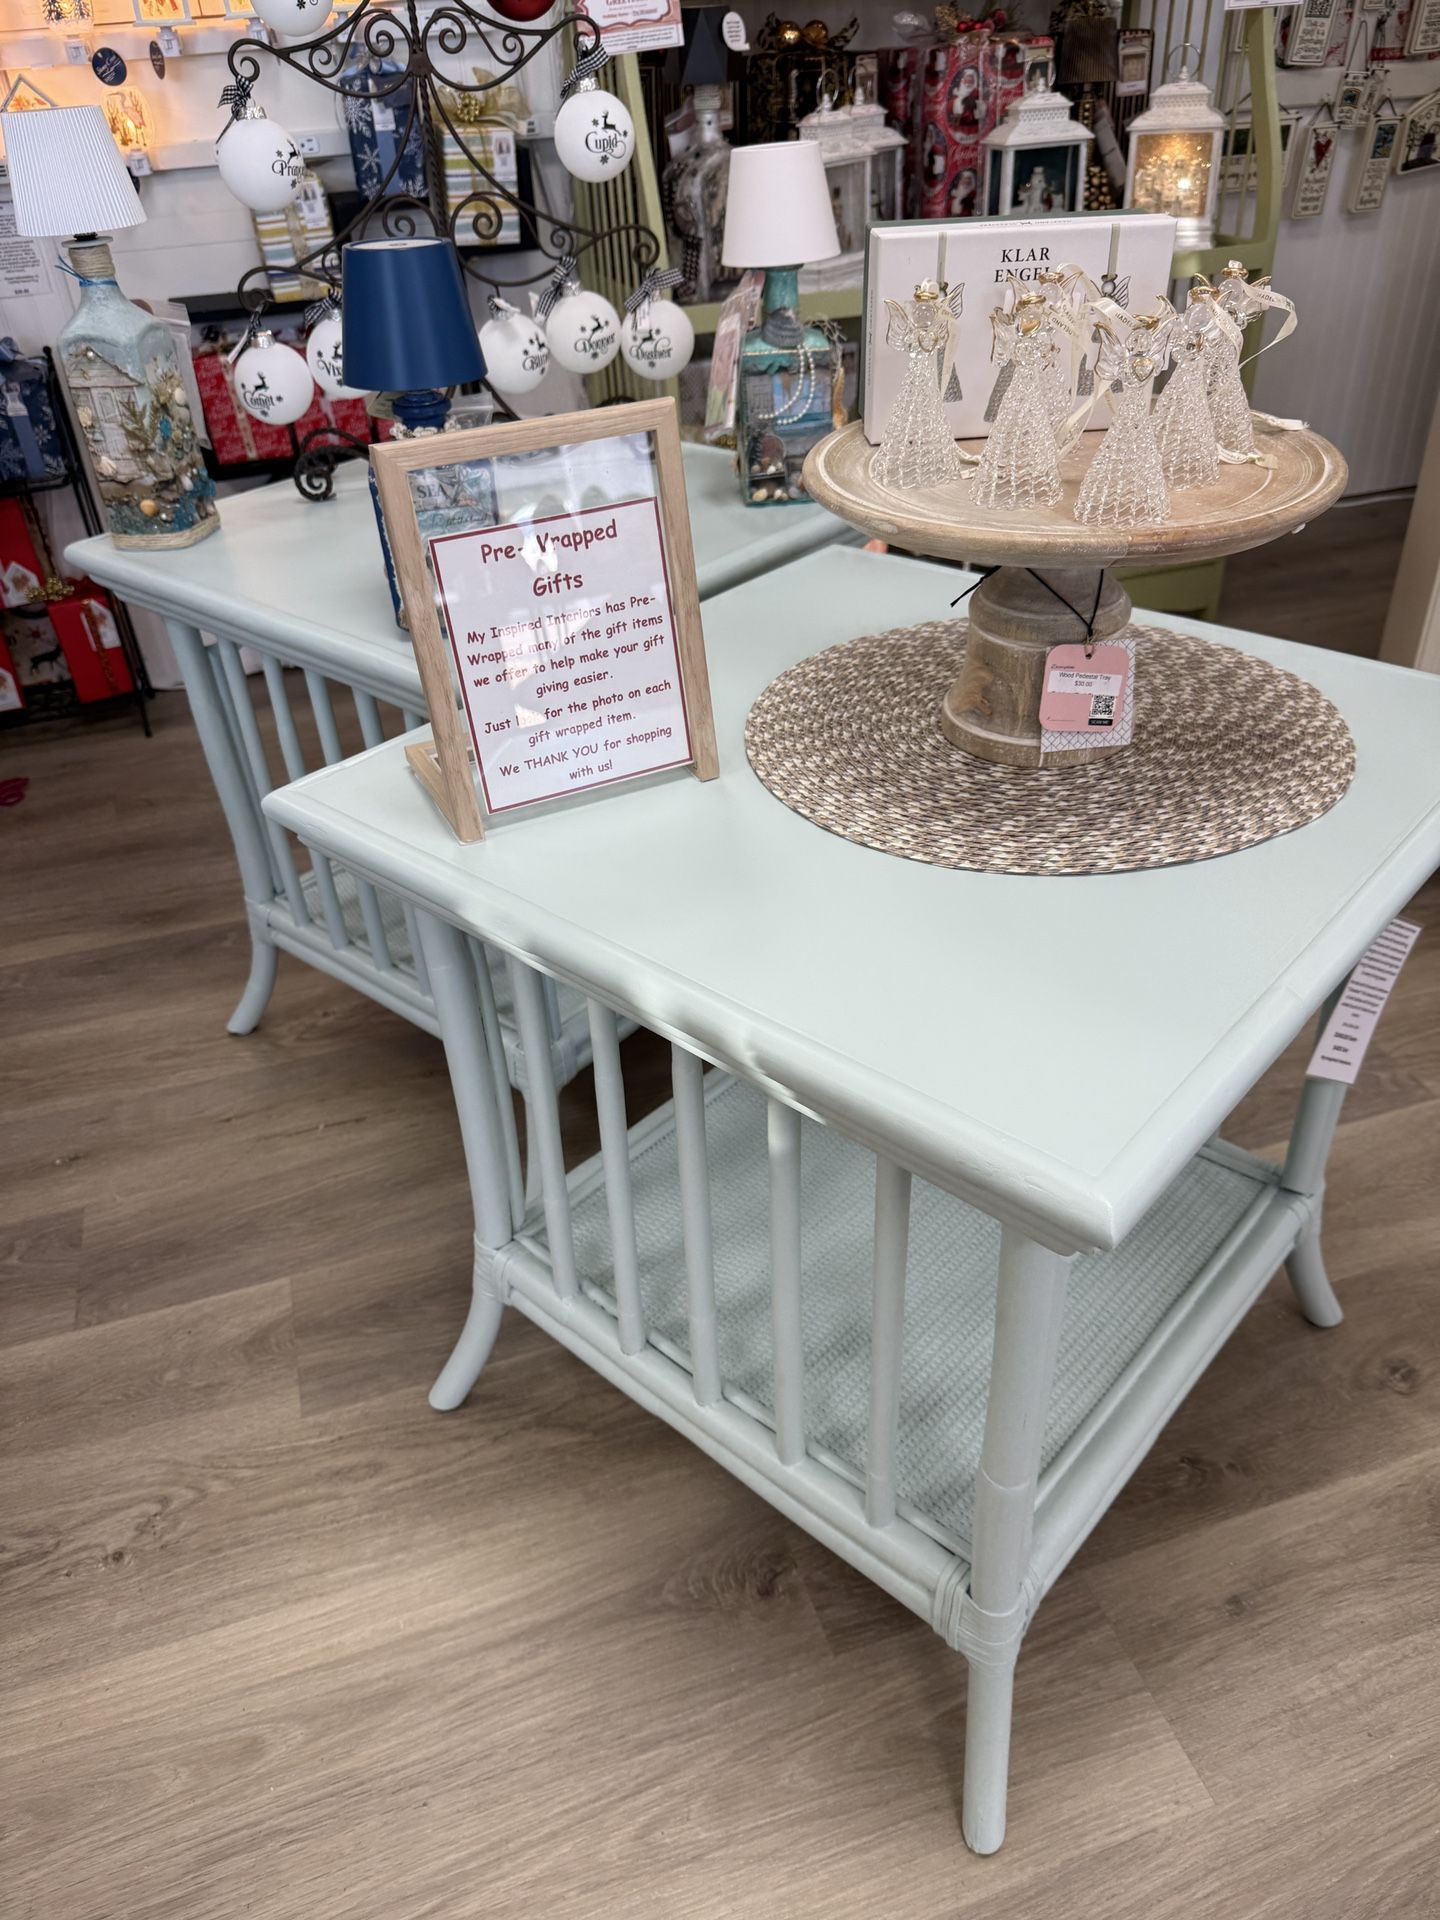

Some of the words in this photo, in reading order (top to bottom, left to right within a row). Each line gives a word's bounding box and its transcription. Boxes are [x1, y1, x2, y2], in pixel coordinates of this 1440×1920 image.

[585, 131, 627, 159] Cupid
[1001, 247, 1051, 263] KLAR
[318, 360, 343, 377] Vix
[243, 390, 275, 410] Comet
[481, 543, 523, 563] Pre-
[533, 572, 583, 596] Gifts
[467, 631, 486, 644] My
[490, 617, 542, 638] Inspired
[546, 607, 601, 626] Interiors
[605, 602, 626, 613] has
[630, 596, 656, 608] Pre-
[467, 644, 523, 666] Wrapped
[528, 640, 559, 653] many
[563, 632, 576, 645] of
[581, 628, 601, 641] the
[606, 621, 627, 638] gift
[632, 615, 663, 629] items
[474, 677, 490, 687] we
[495, 667, 528, 682] offer
[533, 664, 546, 674] to
[550, 656, 575, 669] help
[580, 649, 609, 663] make
[614, 642, 639, 658] your
[643, 634, 664, 651] gift
[536, 680, 569, 698] giving
[573, 671, 613, 686] easier.
[484, 719, 511, 734] Just
[544, 708, 563, 719] for
[568, 701, 588, 713] the
[592, 693, 624, 711] photo
[628, 689, 641, 699] on
[645, 680, 671, 694] each
[528, 730, 550, 747] gift
[555, 717, 603, 738] wrapped
[607, 712, 636, 725] item.
[499, 764, 520, 776] We
[524, 751, 569, 769] THANK
[572, 744, 599, 758] YOU
[604, 739, 622, 751] for
[626, 727, 672, 745] shopping
[569, 765, 593, 780] with
[598, 760, 613, 773] us!
